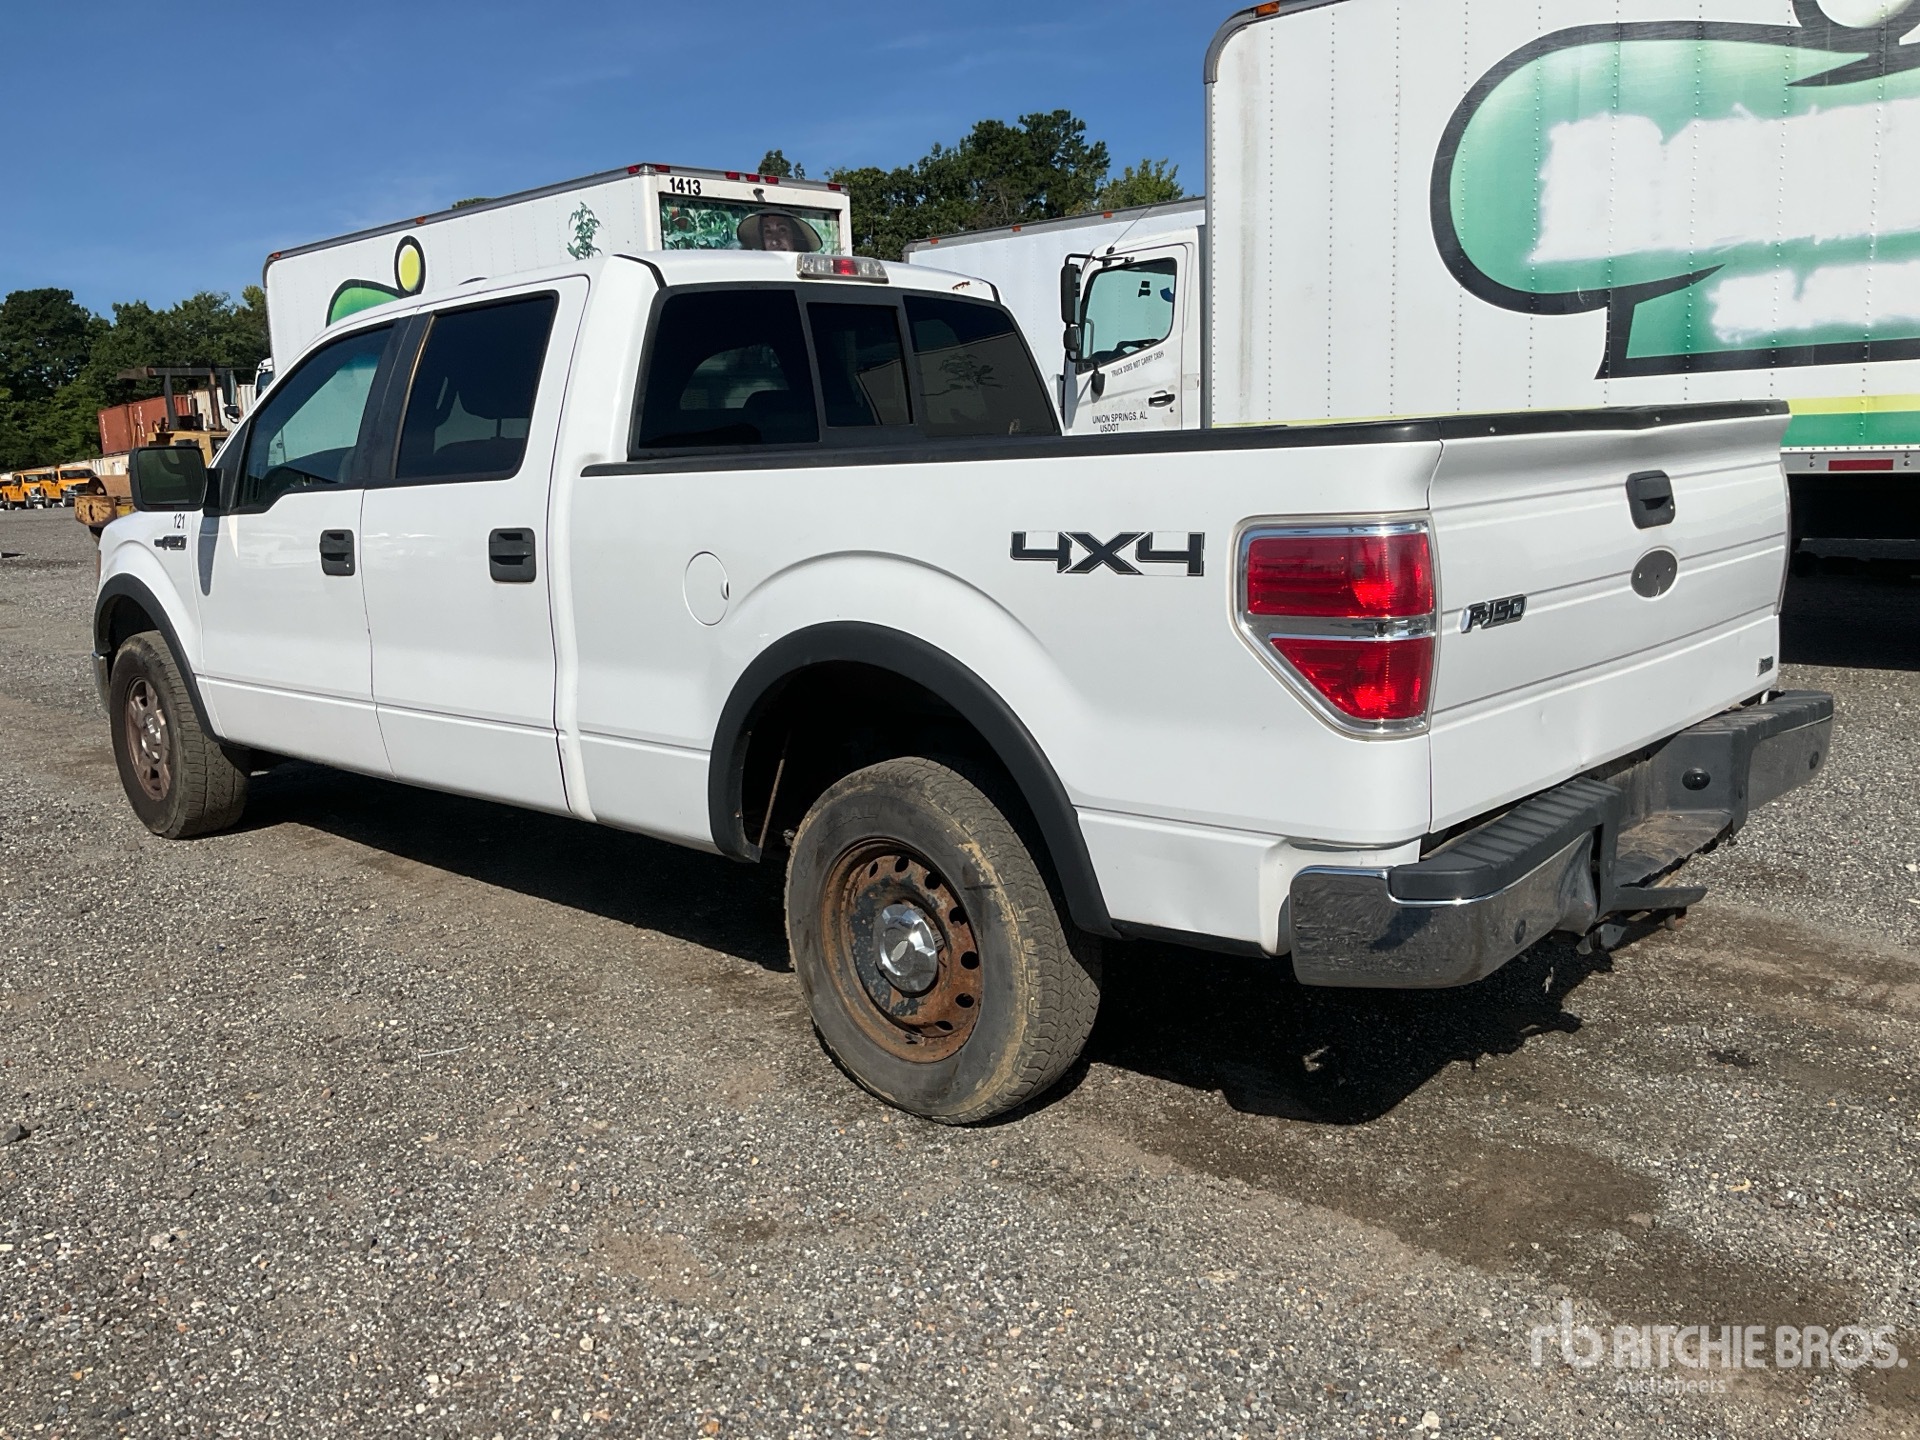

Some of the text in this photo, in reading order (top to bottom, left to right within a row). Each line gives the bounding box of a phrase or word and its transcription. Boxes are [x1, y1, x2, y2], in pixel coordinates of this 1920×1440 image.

[669, 177, 702, 196] 1413
[1111, 367, 1123, 377] TRUCK
[1133, 359, 1141, 368] NOT
[1092, 414, 1110, 424] UNION
[1139, 410, 1148, 420] AL
[1099, 423, 1119, 433] USDOT
[173, 513, 186, 529] 121
